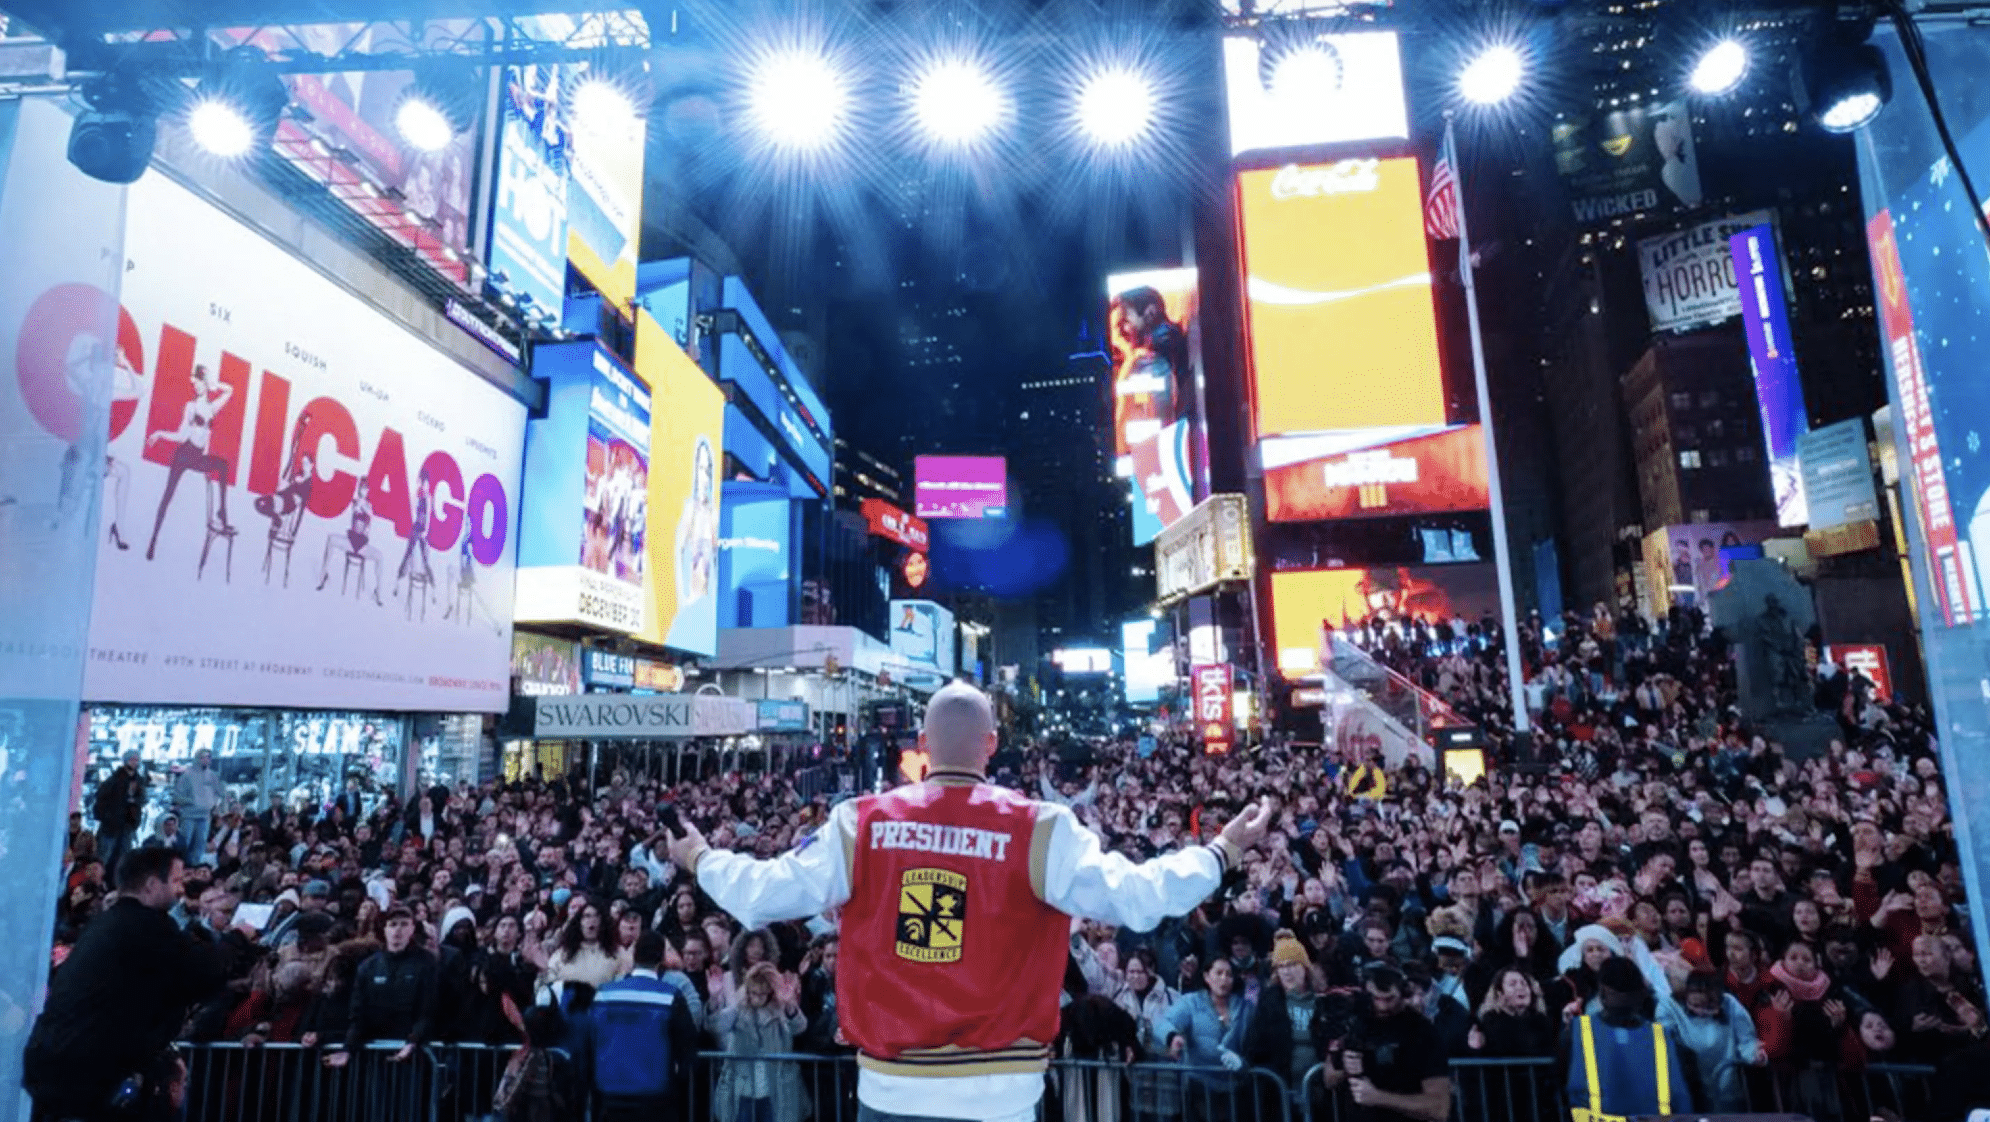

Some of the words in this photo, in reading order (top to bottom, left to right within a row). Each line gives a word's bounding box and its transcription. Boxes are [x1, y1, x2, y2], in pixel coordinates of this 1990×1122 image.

[1571, 189, 1658, 221] WICKED
[1652, 226, 1715, 268] LITTLE
[1656, 255, 1738, 317] HORRO
[209, 302, 232, 322] SIX
[284, 341, 328, 370] SQUISH
[16, 281, 508, 567] CHICAGO
[1922, 453, 1951, 531] STORE
[90, 647, 148, 666] THEATRE
[199, 657, 240, 672] STREET
[260, 664, 313, 677] BROADWAY
[592, 652, 617, 672] BLUE
[1201, 668, 1222, 721] tkts
[538, 703, 691, 728] SWAROVSKI
[293, 718, 362, 755] SLAM
[870, 820, 1013, 862] PRESIDENT
[905, 870, 966, 891] LEADERSHIP
[899, 943, 960, 961] EXCELLENCE
